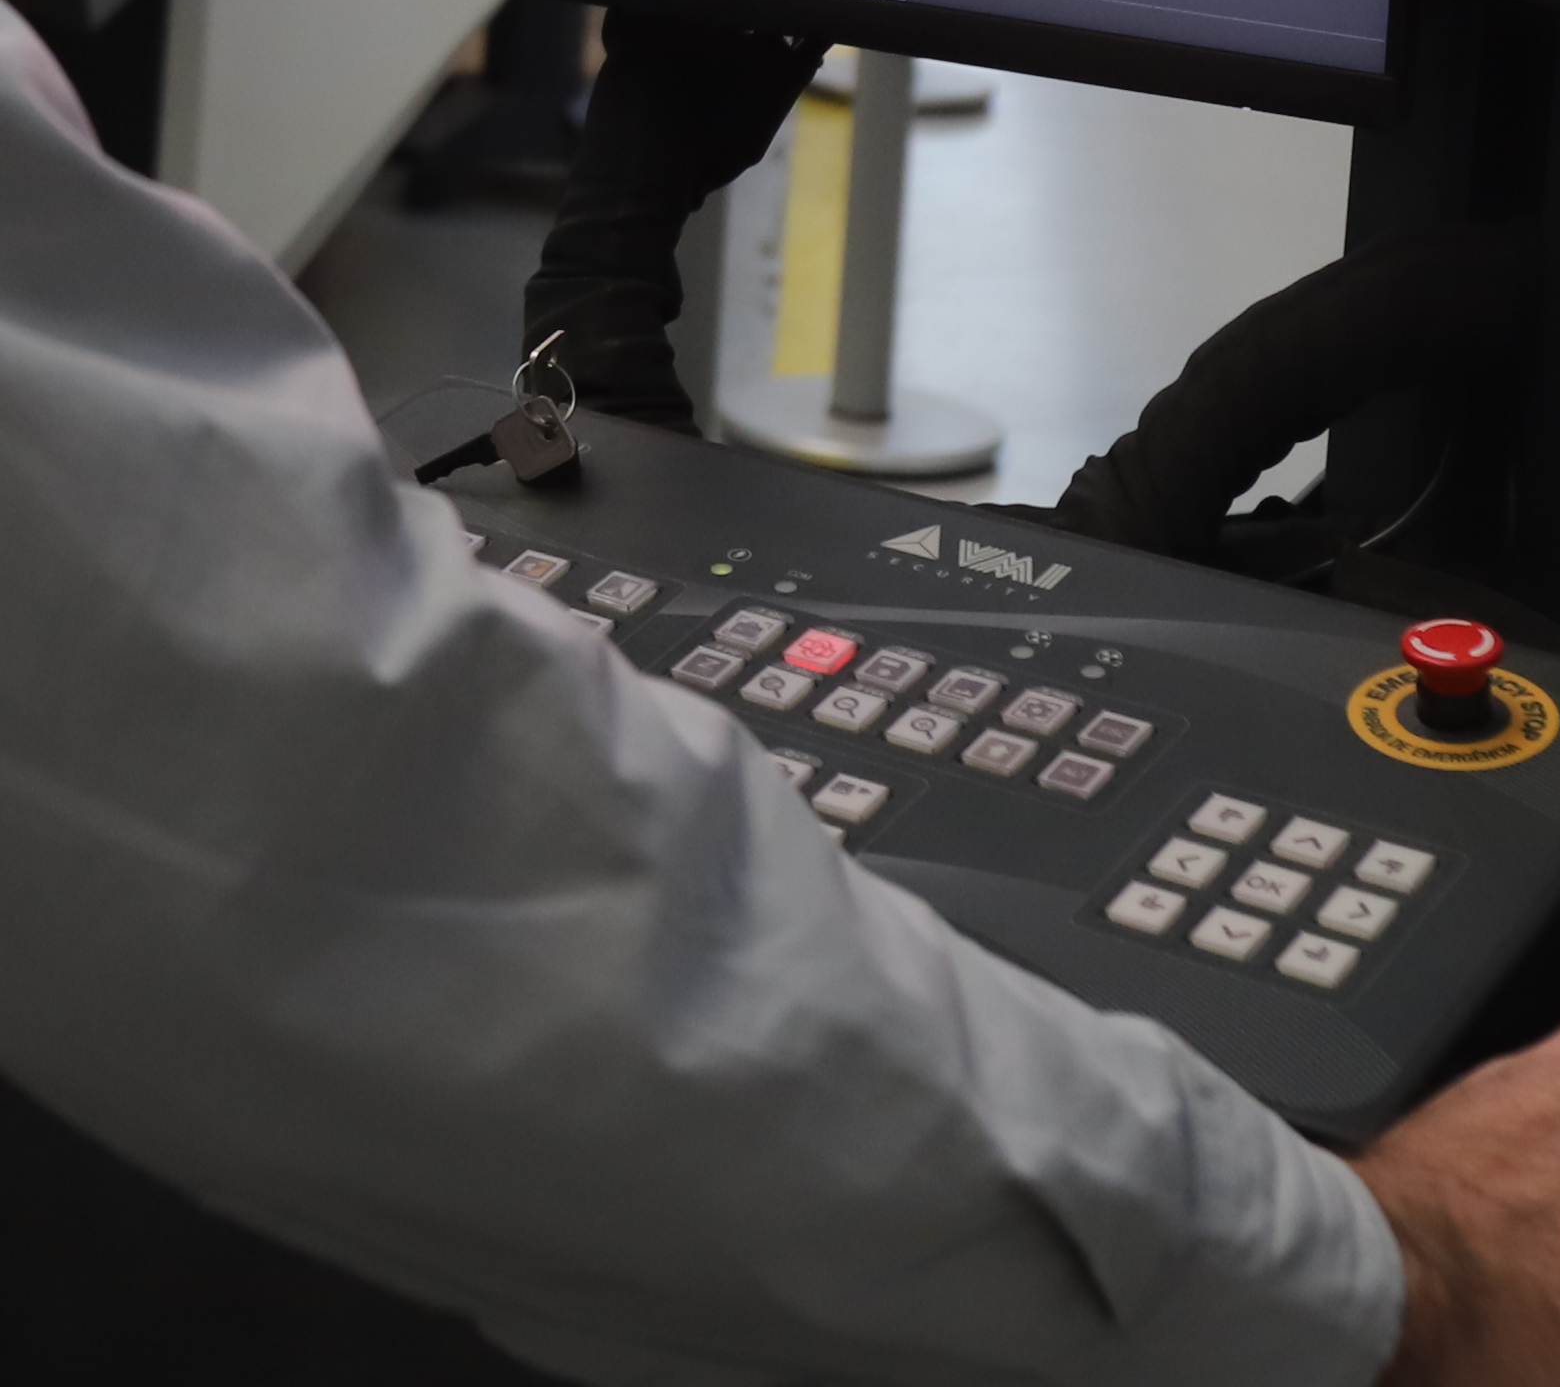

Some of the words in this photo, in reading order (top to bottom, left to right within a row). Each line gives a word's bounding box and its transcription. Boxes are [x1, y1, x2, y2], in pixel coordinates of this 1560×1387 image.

[866, 551, 1040, 602] SECURITY
[958, 538, 1073, 591] VMI
[1521, 701, 1548, 742] STOP
[1247, 875, 1286, 898] OK
